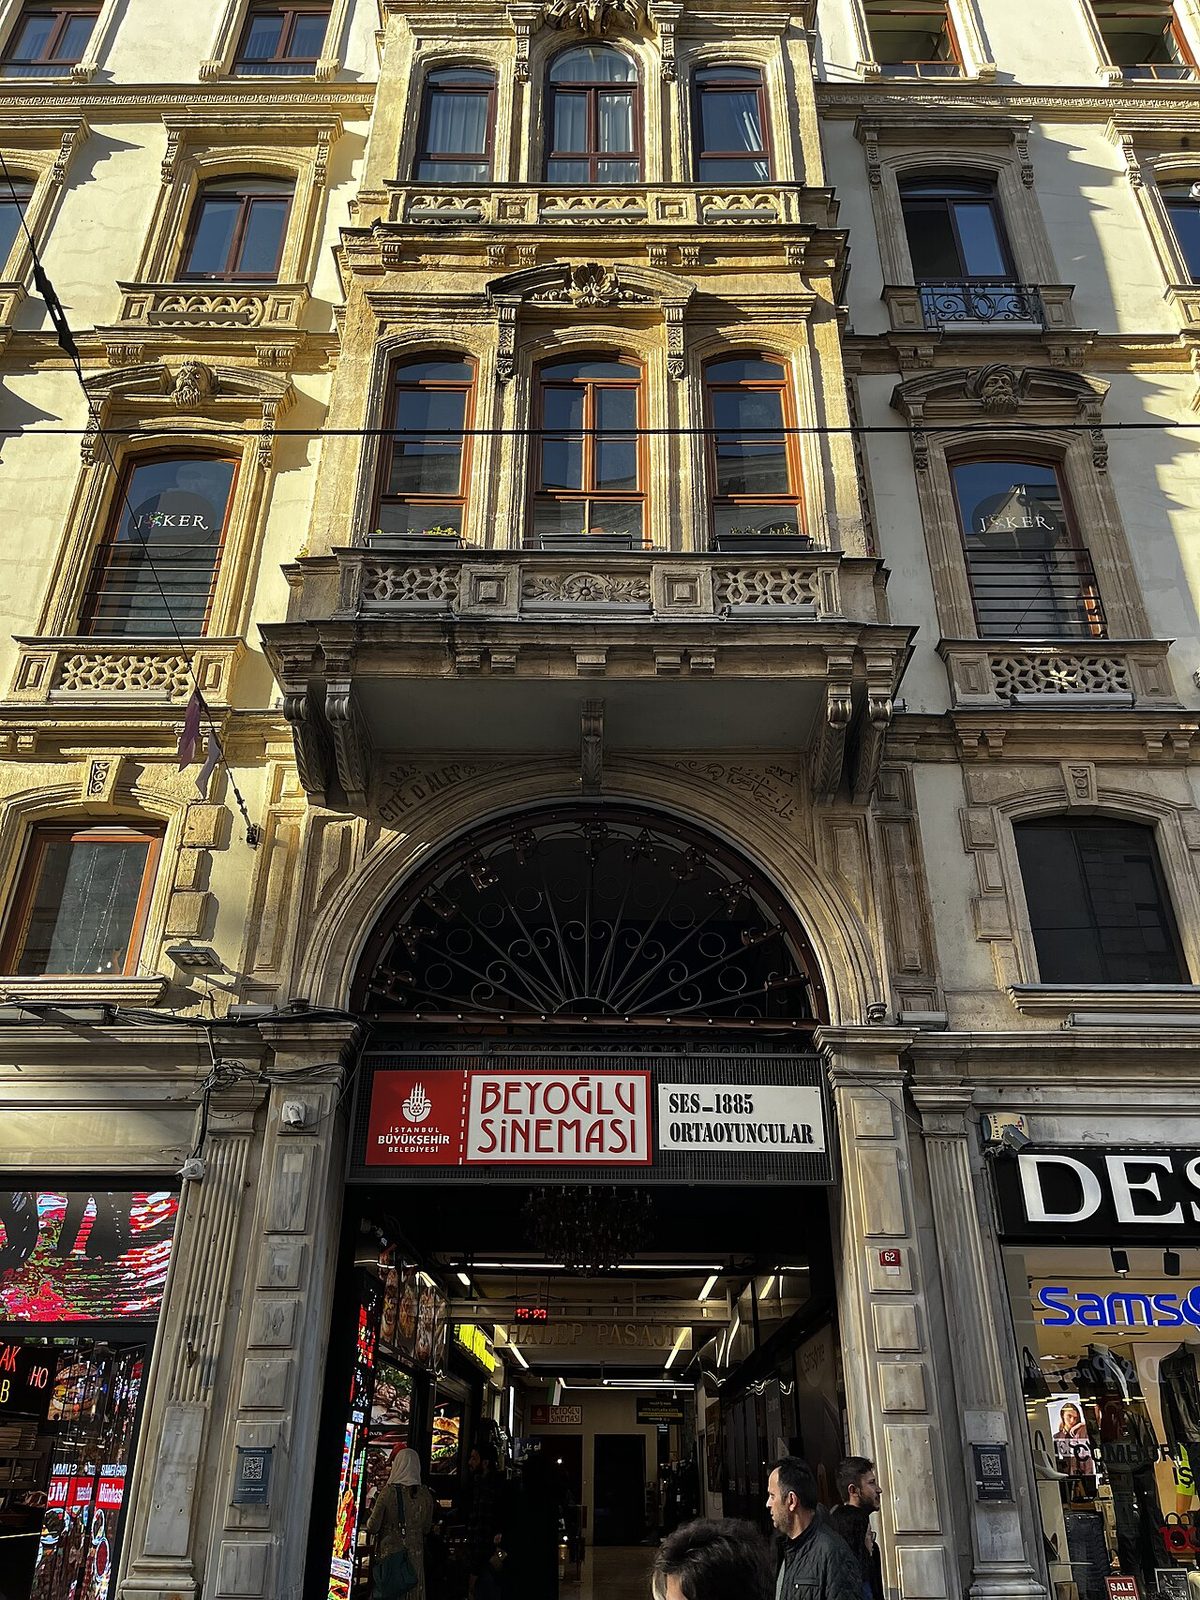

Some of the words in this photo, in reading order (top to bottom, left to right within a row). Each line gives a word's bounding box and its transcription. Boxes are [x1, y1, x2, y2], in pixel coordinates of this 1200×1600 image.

[480, 1076, 636, 1115] BEYOĞLU
[378, 1133, 450, 1145] BÜYÜKŞEHİR
[669, 1122, 814, 1144] ORTAOYUNCULAR
[388, 1145, 439, 1153] BELEDİYESİ
[1018, 1154, 1200, 1223] DE
[884, 1252, 896, 1262] 62
[505, 1322, 583, 1346] HALEP
[1110, 1582, 1134, 1592] SALE
